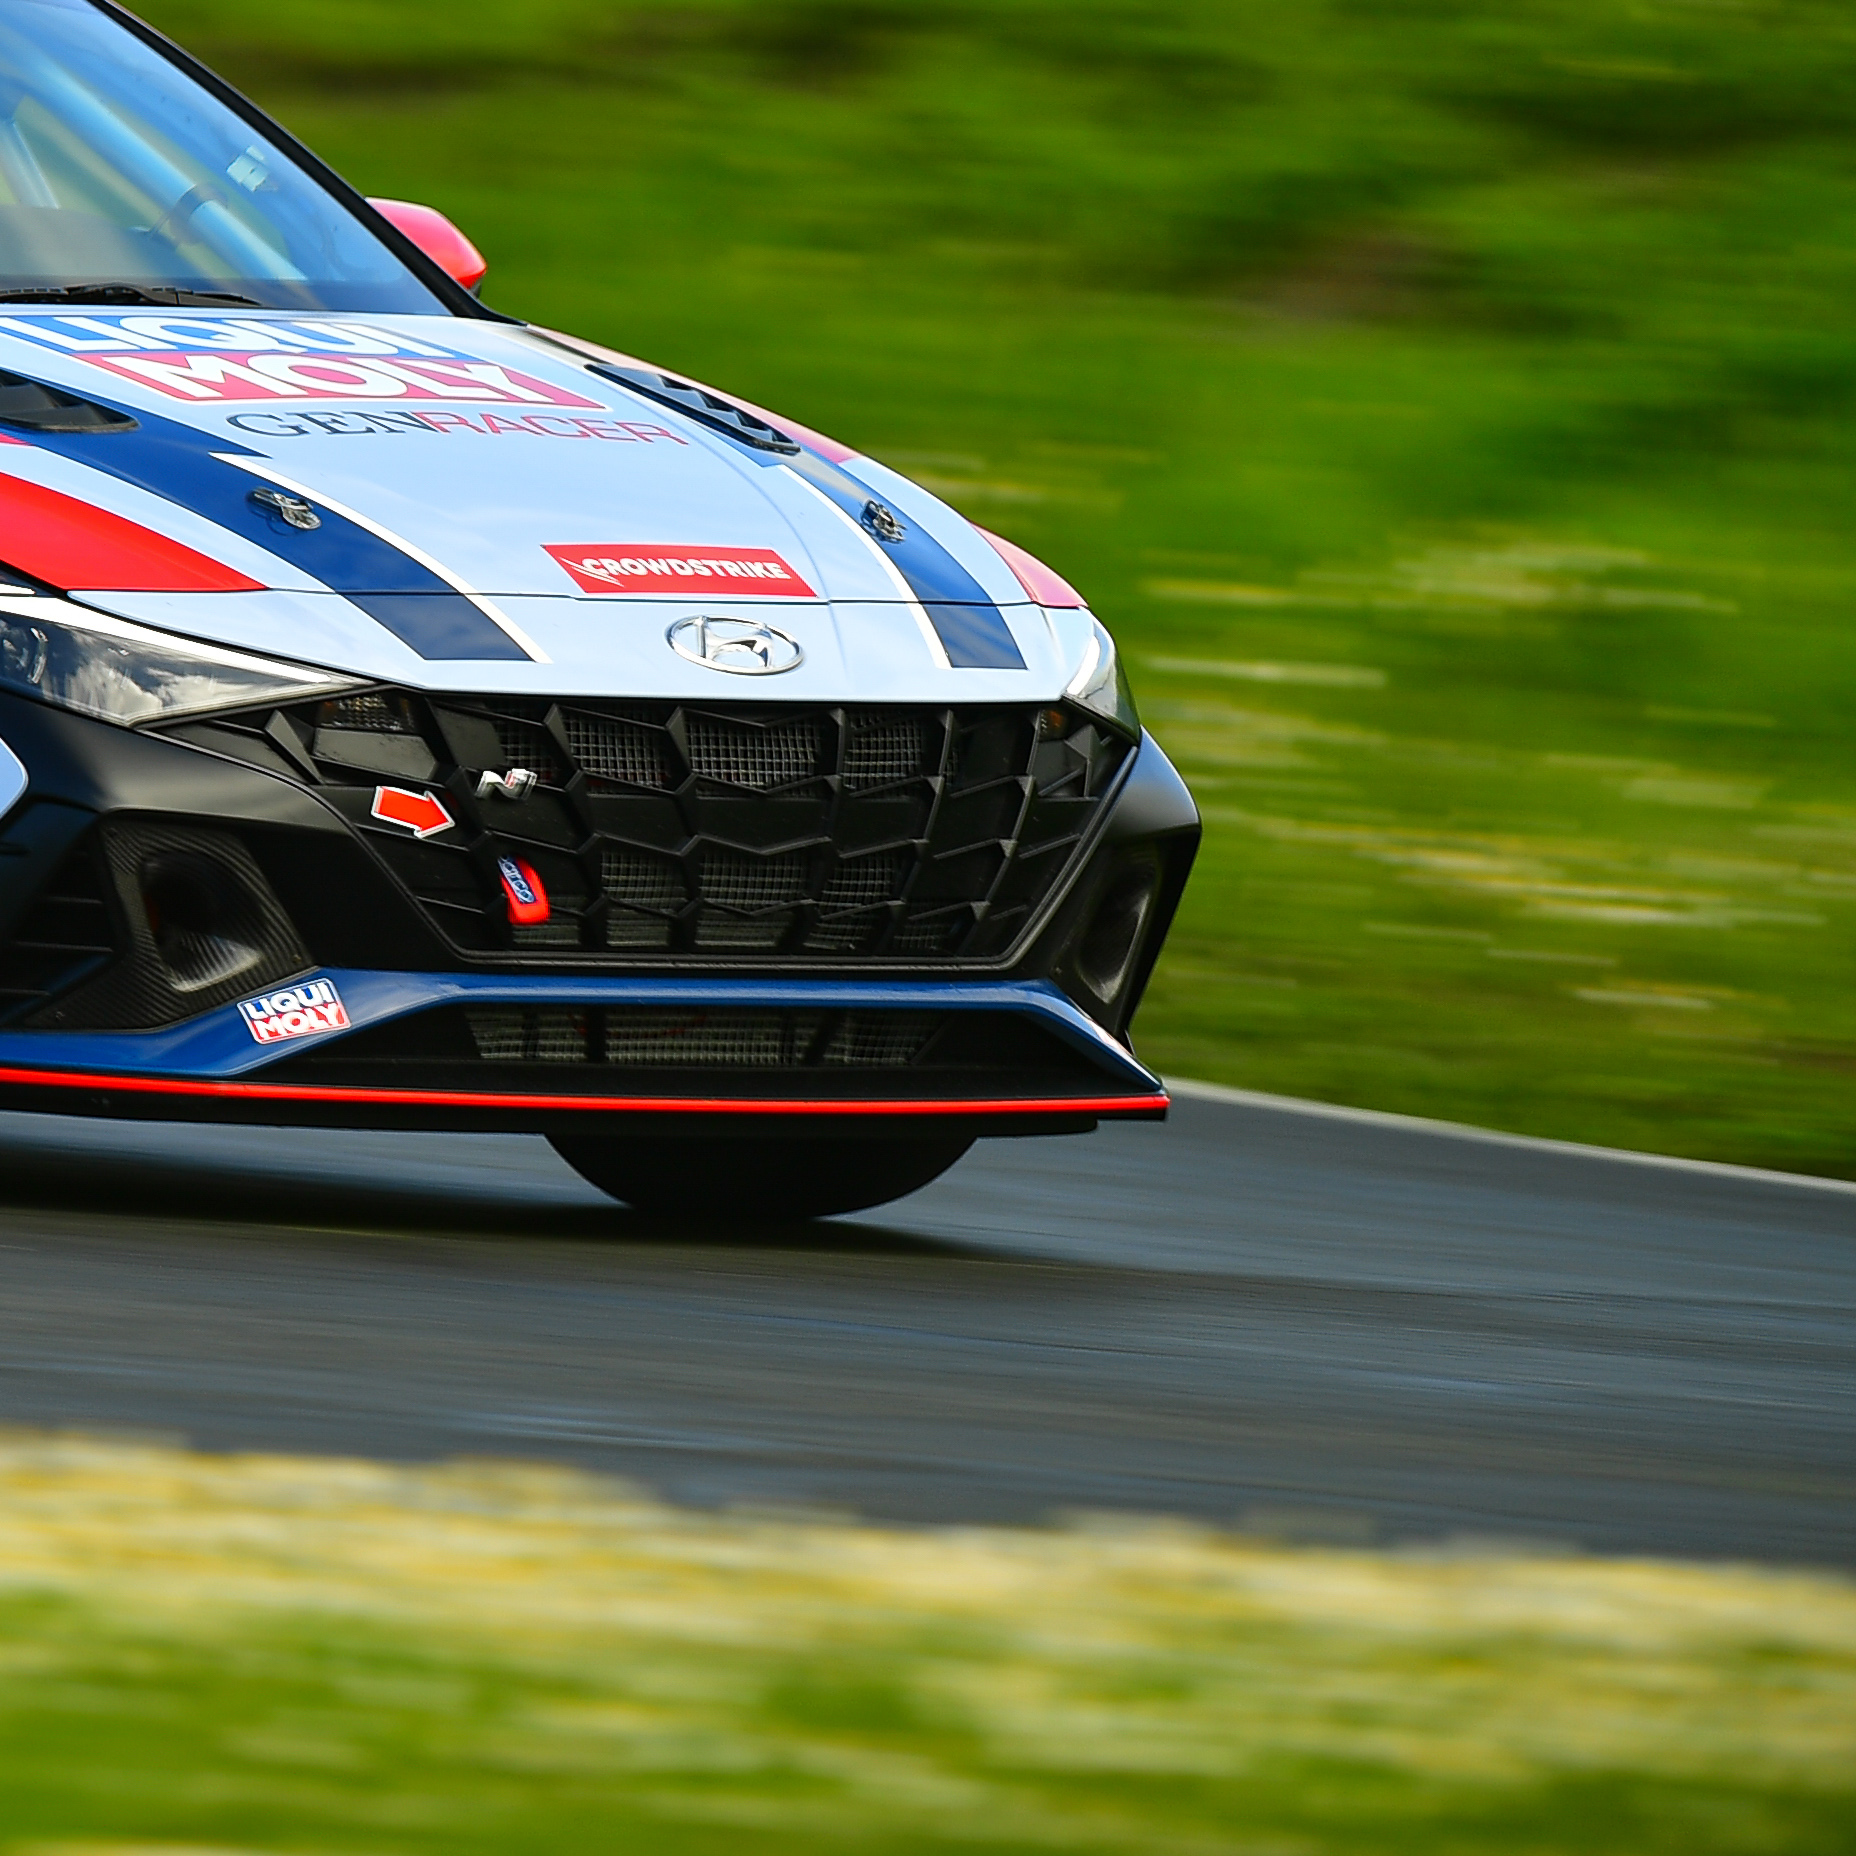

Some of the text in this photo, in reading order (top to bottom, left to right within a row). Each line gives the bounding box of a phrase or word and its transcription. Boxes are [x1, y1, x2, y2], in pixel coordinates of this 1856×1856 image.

[100, 353, 559, 402] MOLY
[225, 410, 689, 446] GENRACER
[581, 558, 792, 580] CROWDSTRIKE
[243, 979, 337, 1021] LIQUI
[254, 1005, 348, 1042] MOLY
